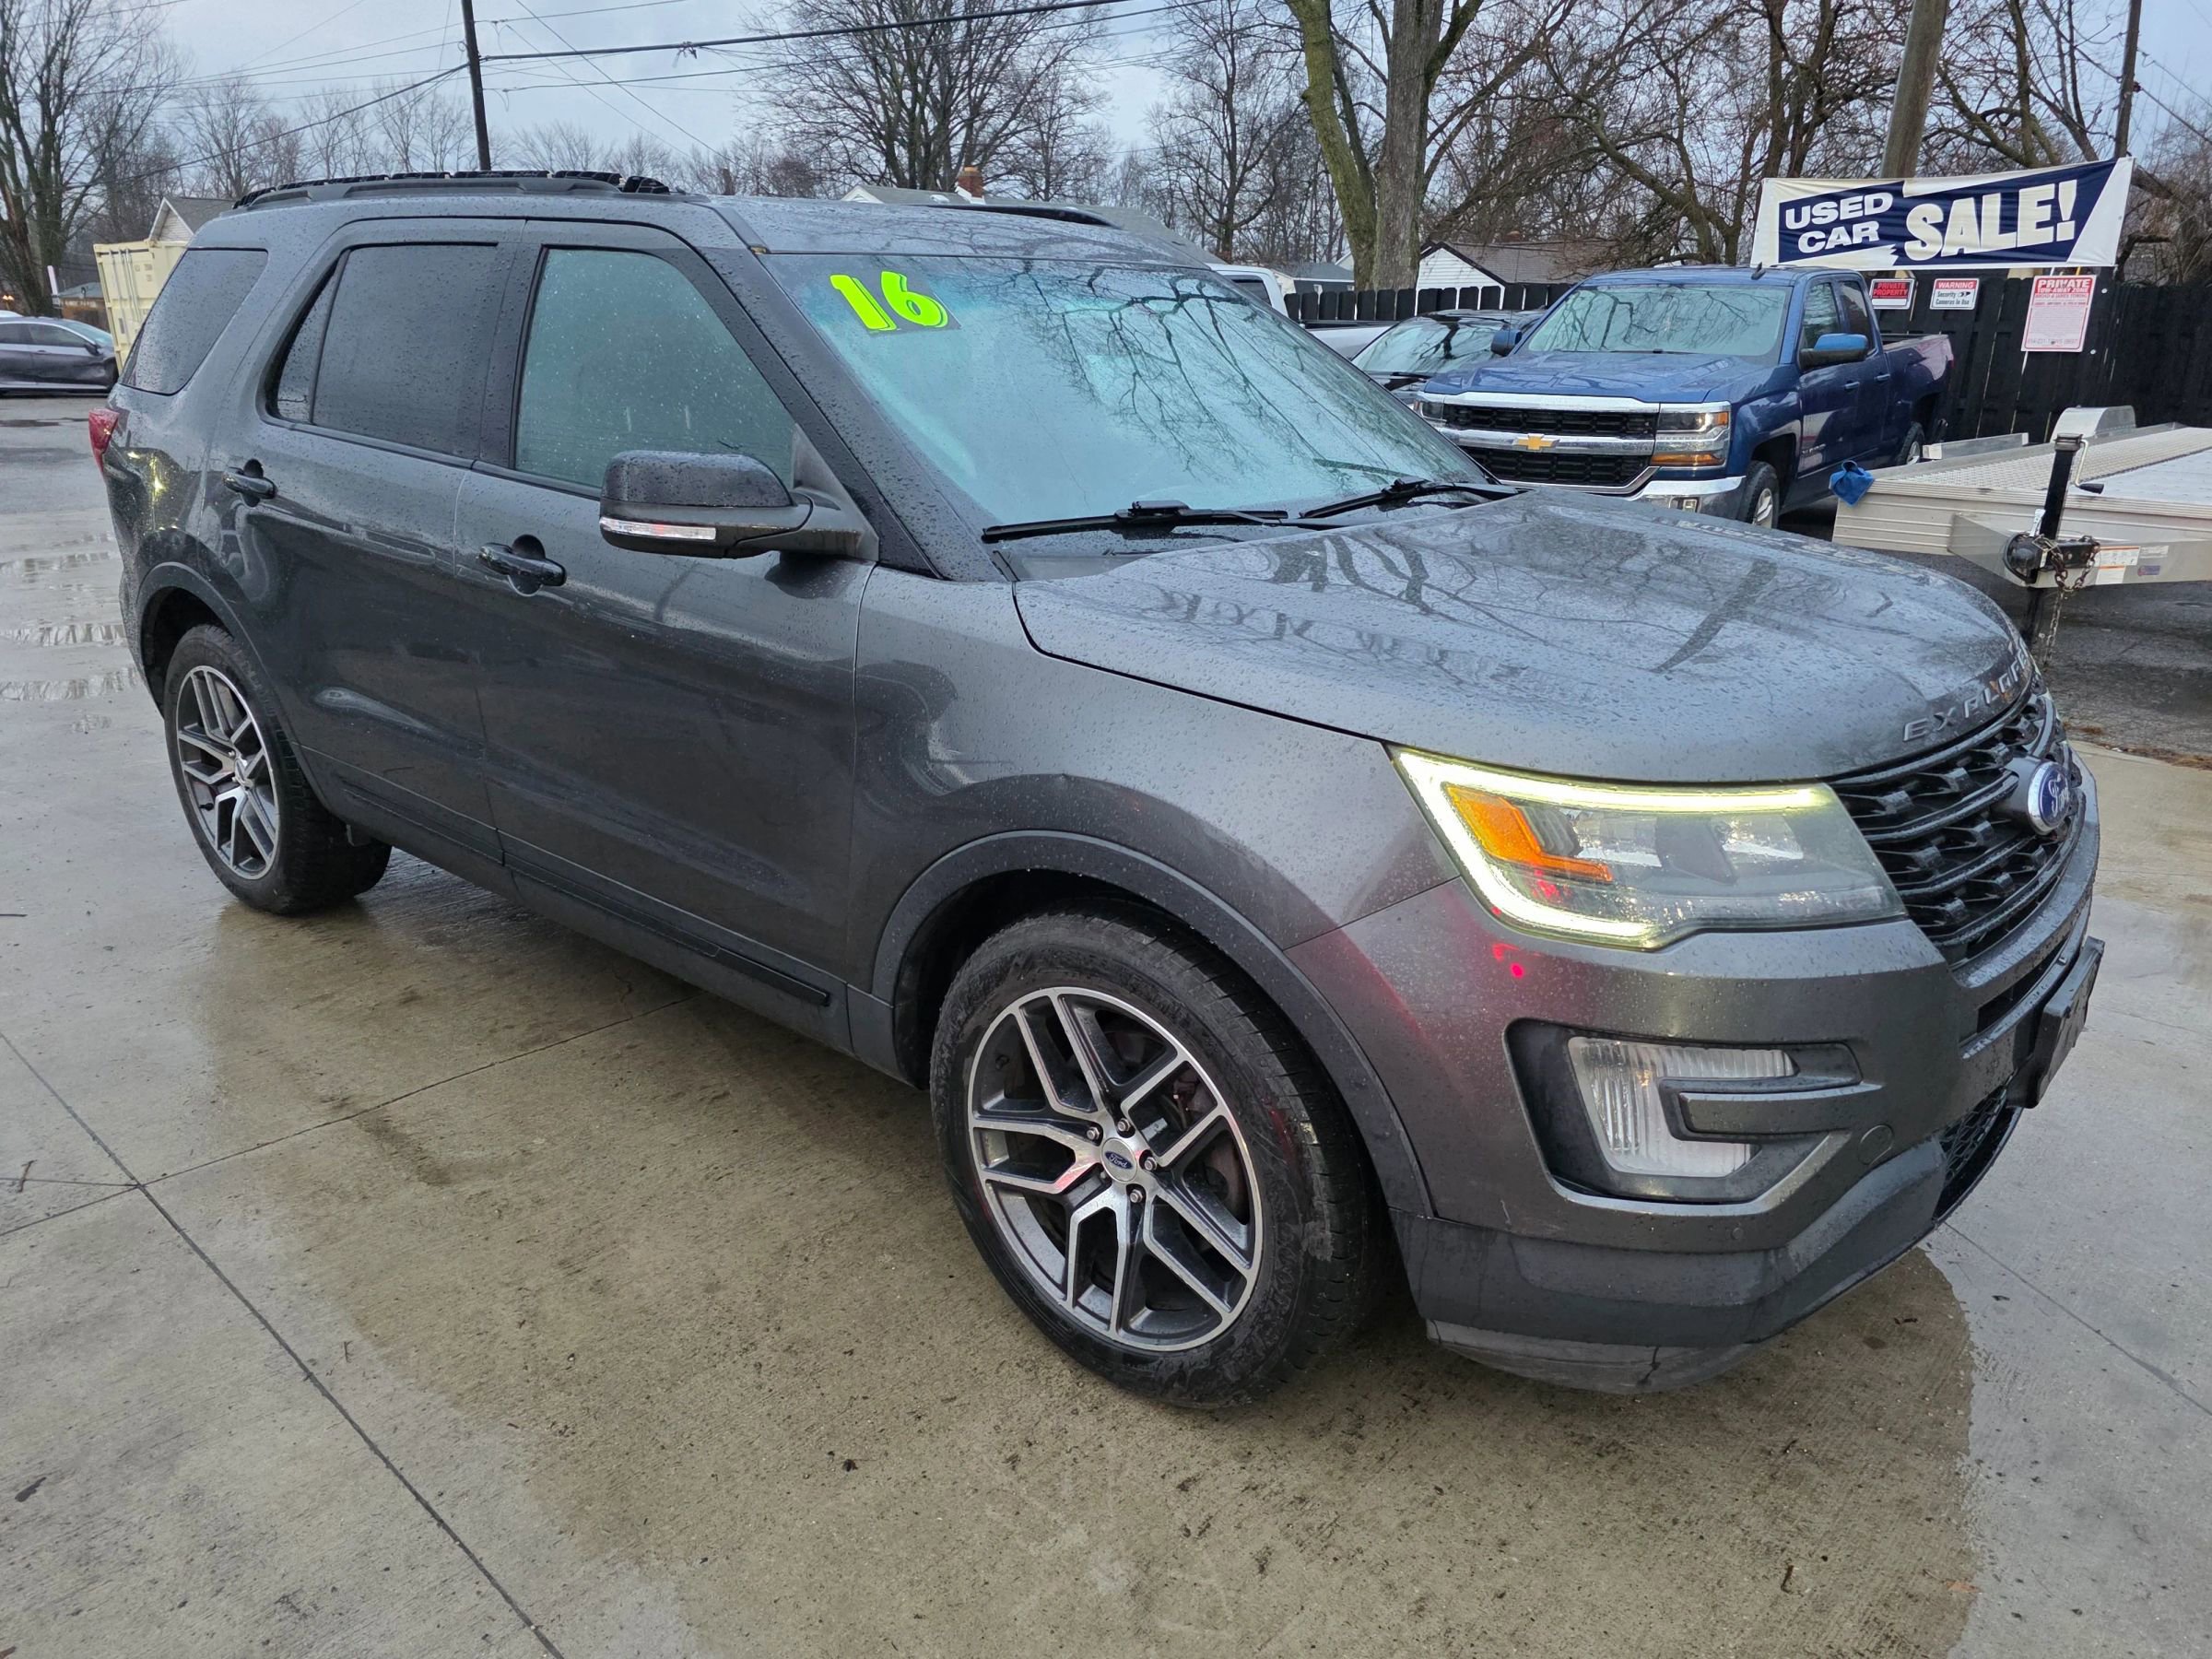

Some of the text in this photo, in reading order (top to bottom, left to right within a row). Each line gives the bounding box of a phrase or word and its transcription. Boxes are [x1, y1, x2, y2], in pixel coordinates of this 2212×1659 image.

[1785, 193, 1893, 229] USED
[1904, 179, 2077, 261] SALE!
[1798, 220, 1880, 253] CAR
[1937, 281, 1974, 289] WARNING
[2038, 279, 2091, 288] PRIVATE
[830, 270, 948, 331] 16
[1936, 290, 1957, 299] Security
[1936, 298, 1955, 306] Cameras
[1109, 1153, 1128, 1168] Ford
